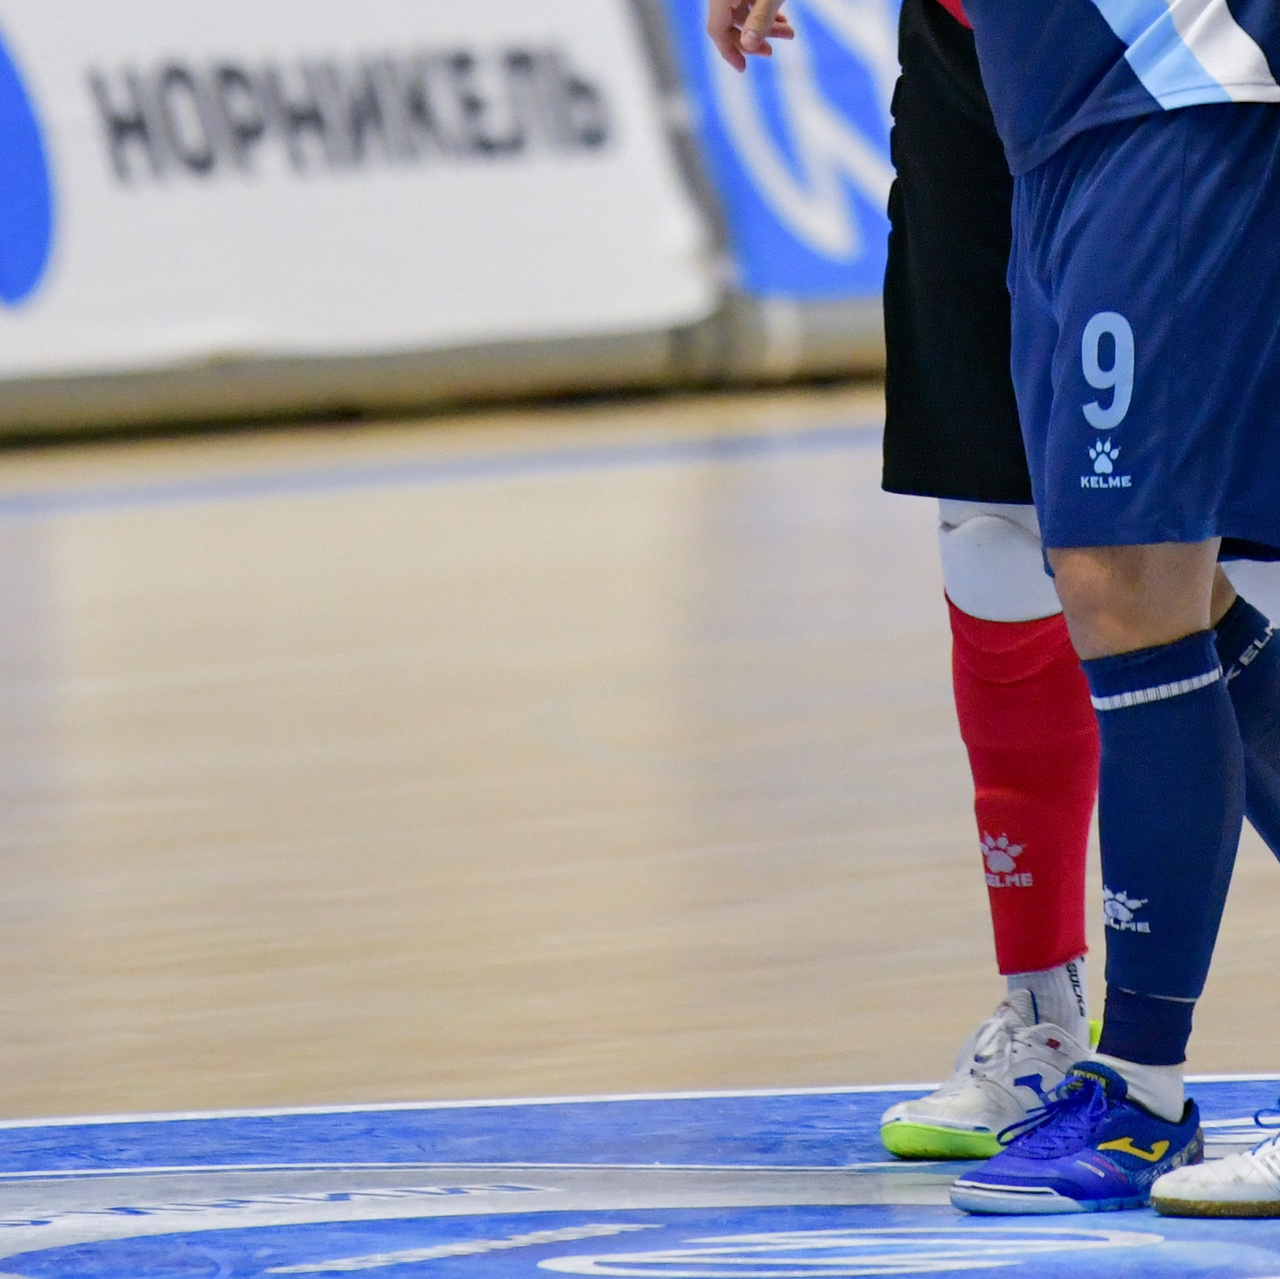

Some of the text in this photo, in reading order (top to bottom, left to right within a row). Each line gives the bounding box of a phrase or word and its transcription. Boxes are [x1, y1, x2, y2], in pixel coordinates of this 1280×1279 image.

[88, 42, 612, 180] НОРНИКЕЛЬ
[1081, 311, 1135, 430] 9
[1081, 475, 1132, 489] KELME
[985, 872, 1034, 888] ELME
[1104, 919, 1151, 933] LME
